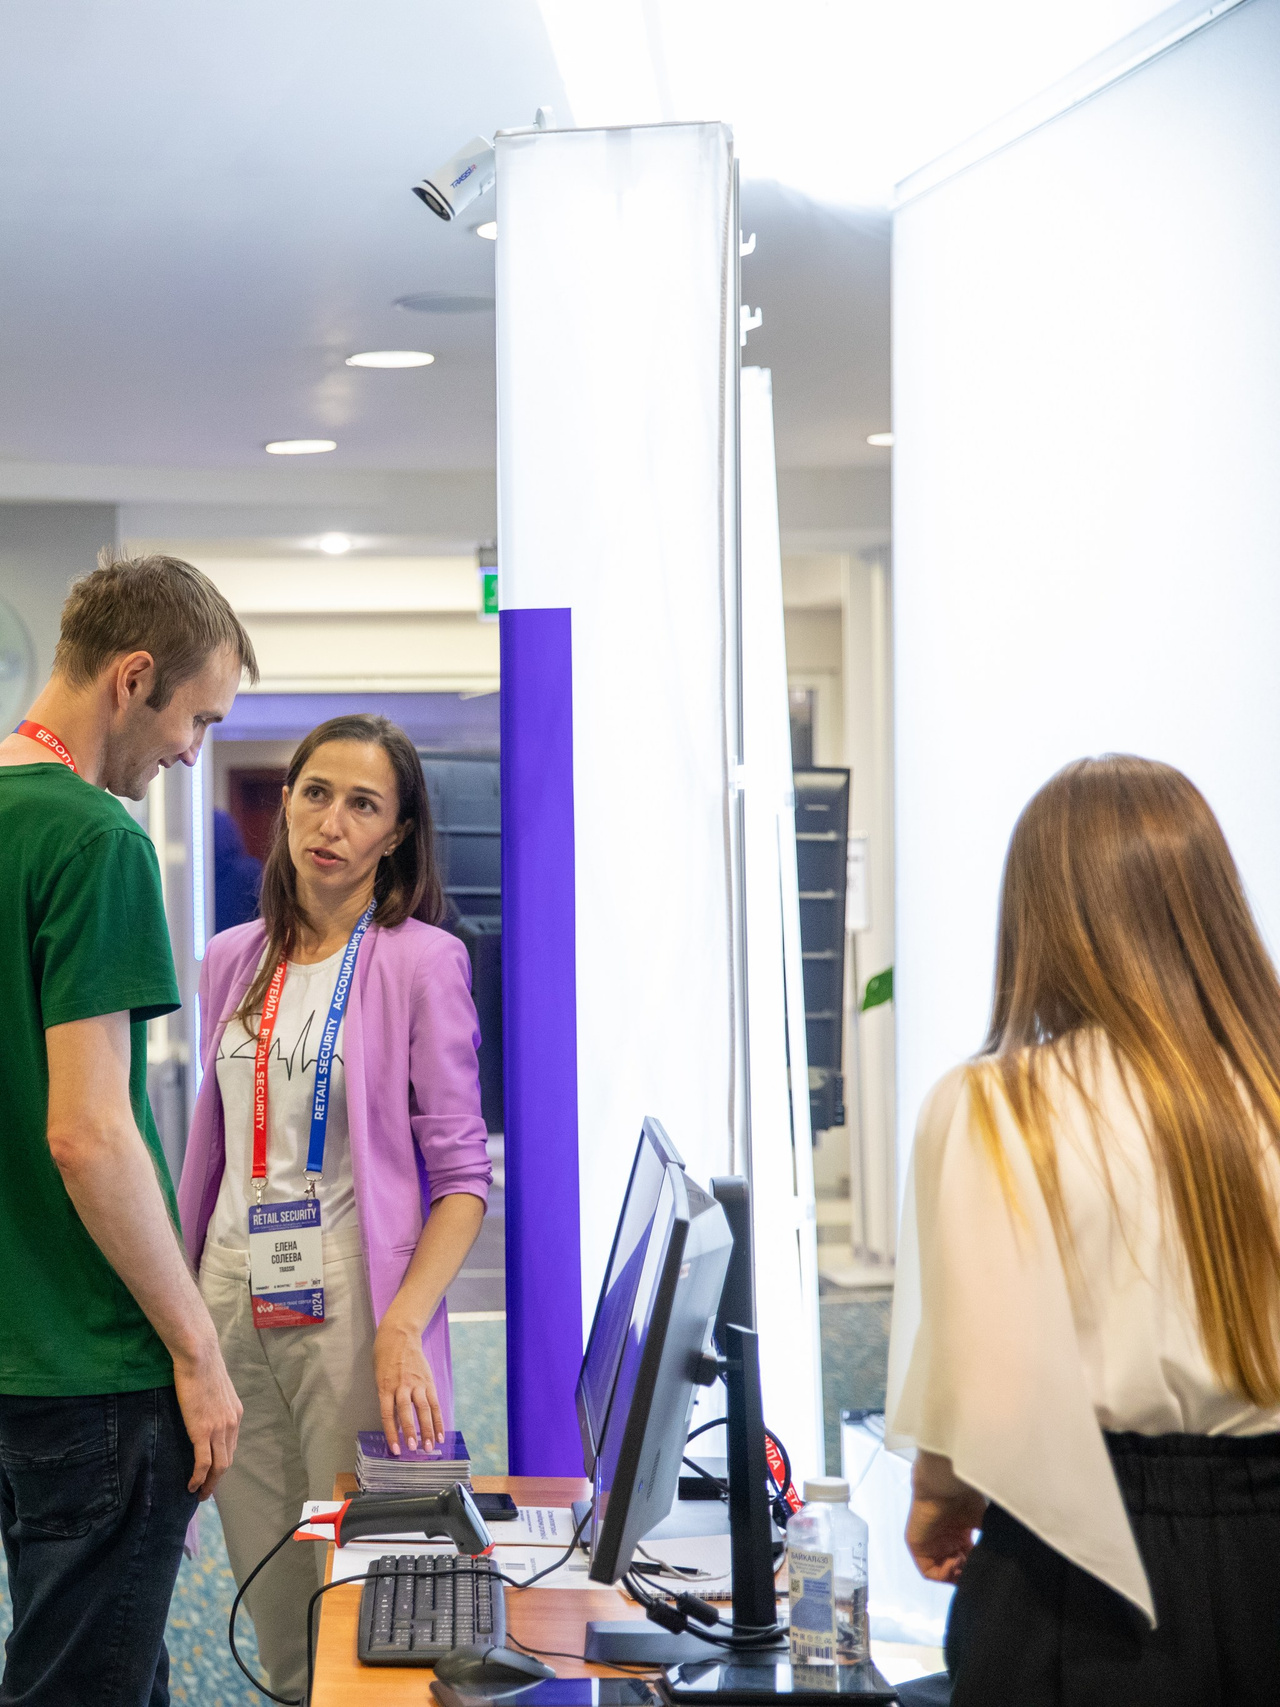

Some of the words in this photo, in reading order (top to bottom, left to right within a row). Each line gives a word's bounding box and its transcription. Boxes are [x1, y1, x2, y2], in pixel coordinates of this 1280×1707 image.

[333, 933, 363, 1010] АССОЦИАЦИЯ
[265, 966, 283, 1020] РИТЕЙЛА
[257, 1028, 270, 1068] RETAIL
[319, 1018, 338, 1074] SECURITY
[255, 1072, 265, 1130] SECURITY
[314, 1077, 326, 1120] RETAIL
[253, 1213, 279, 1226] RETAIL
[281, 1208, 317, 1223] SECURITY
[271, 1252, 302, 1265] СОЛЕЕВА
[275, 1241, 297, 1252] ЕЛЕНА
[312, 1292, 322, 1316] 2024
